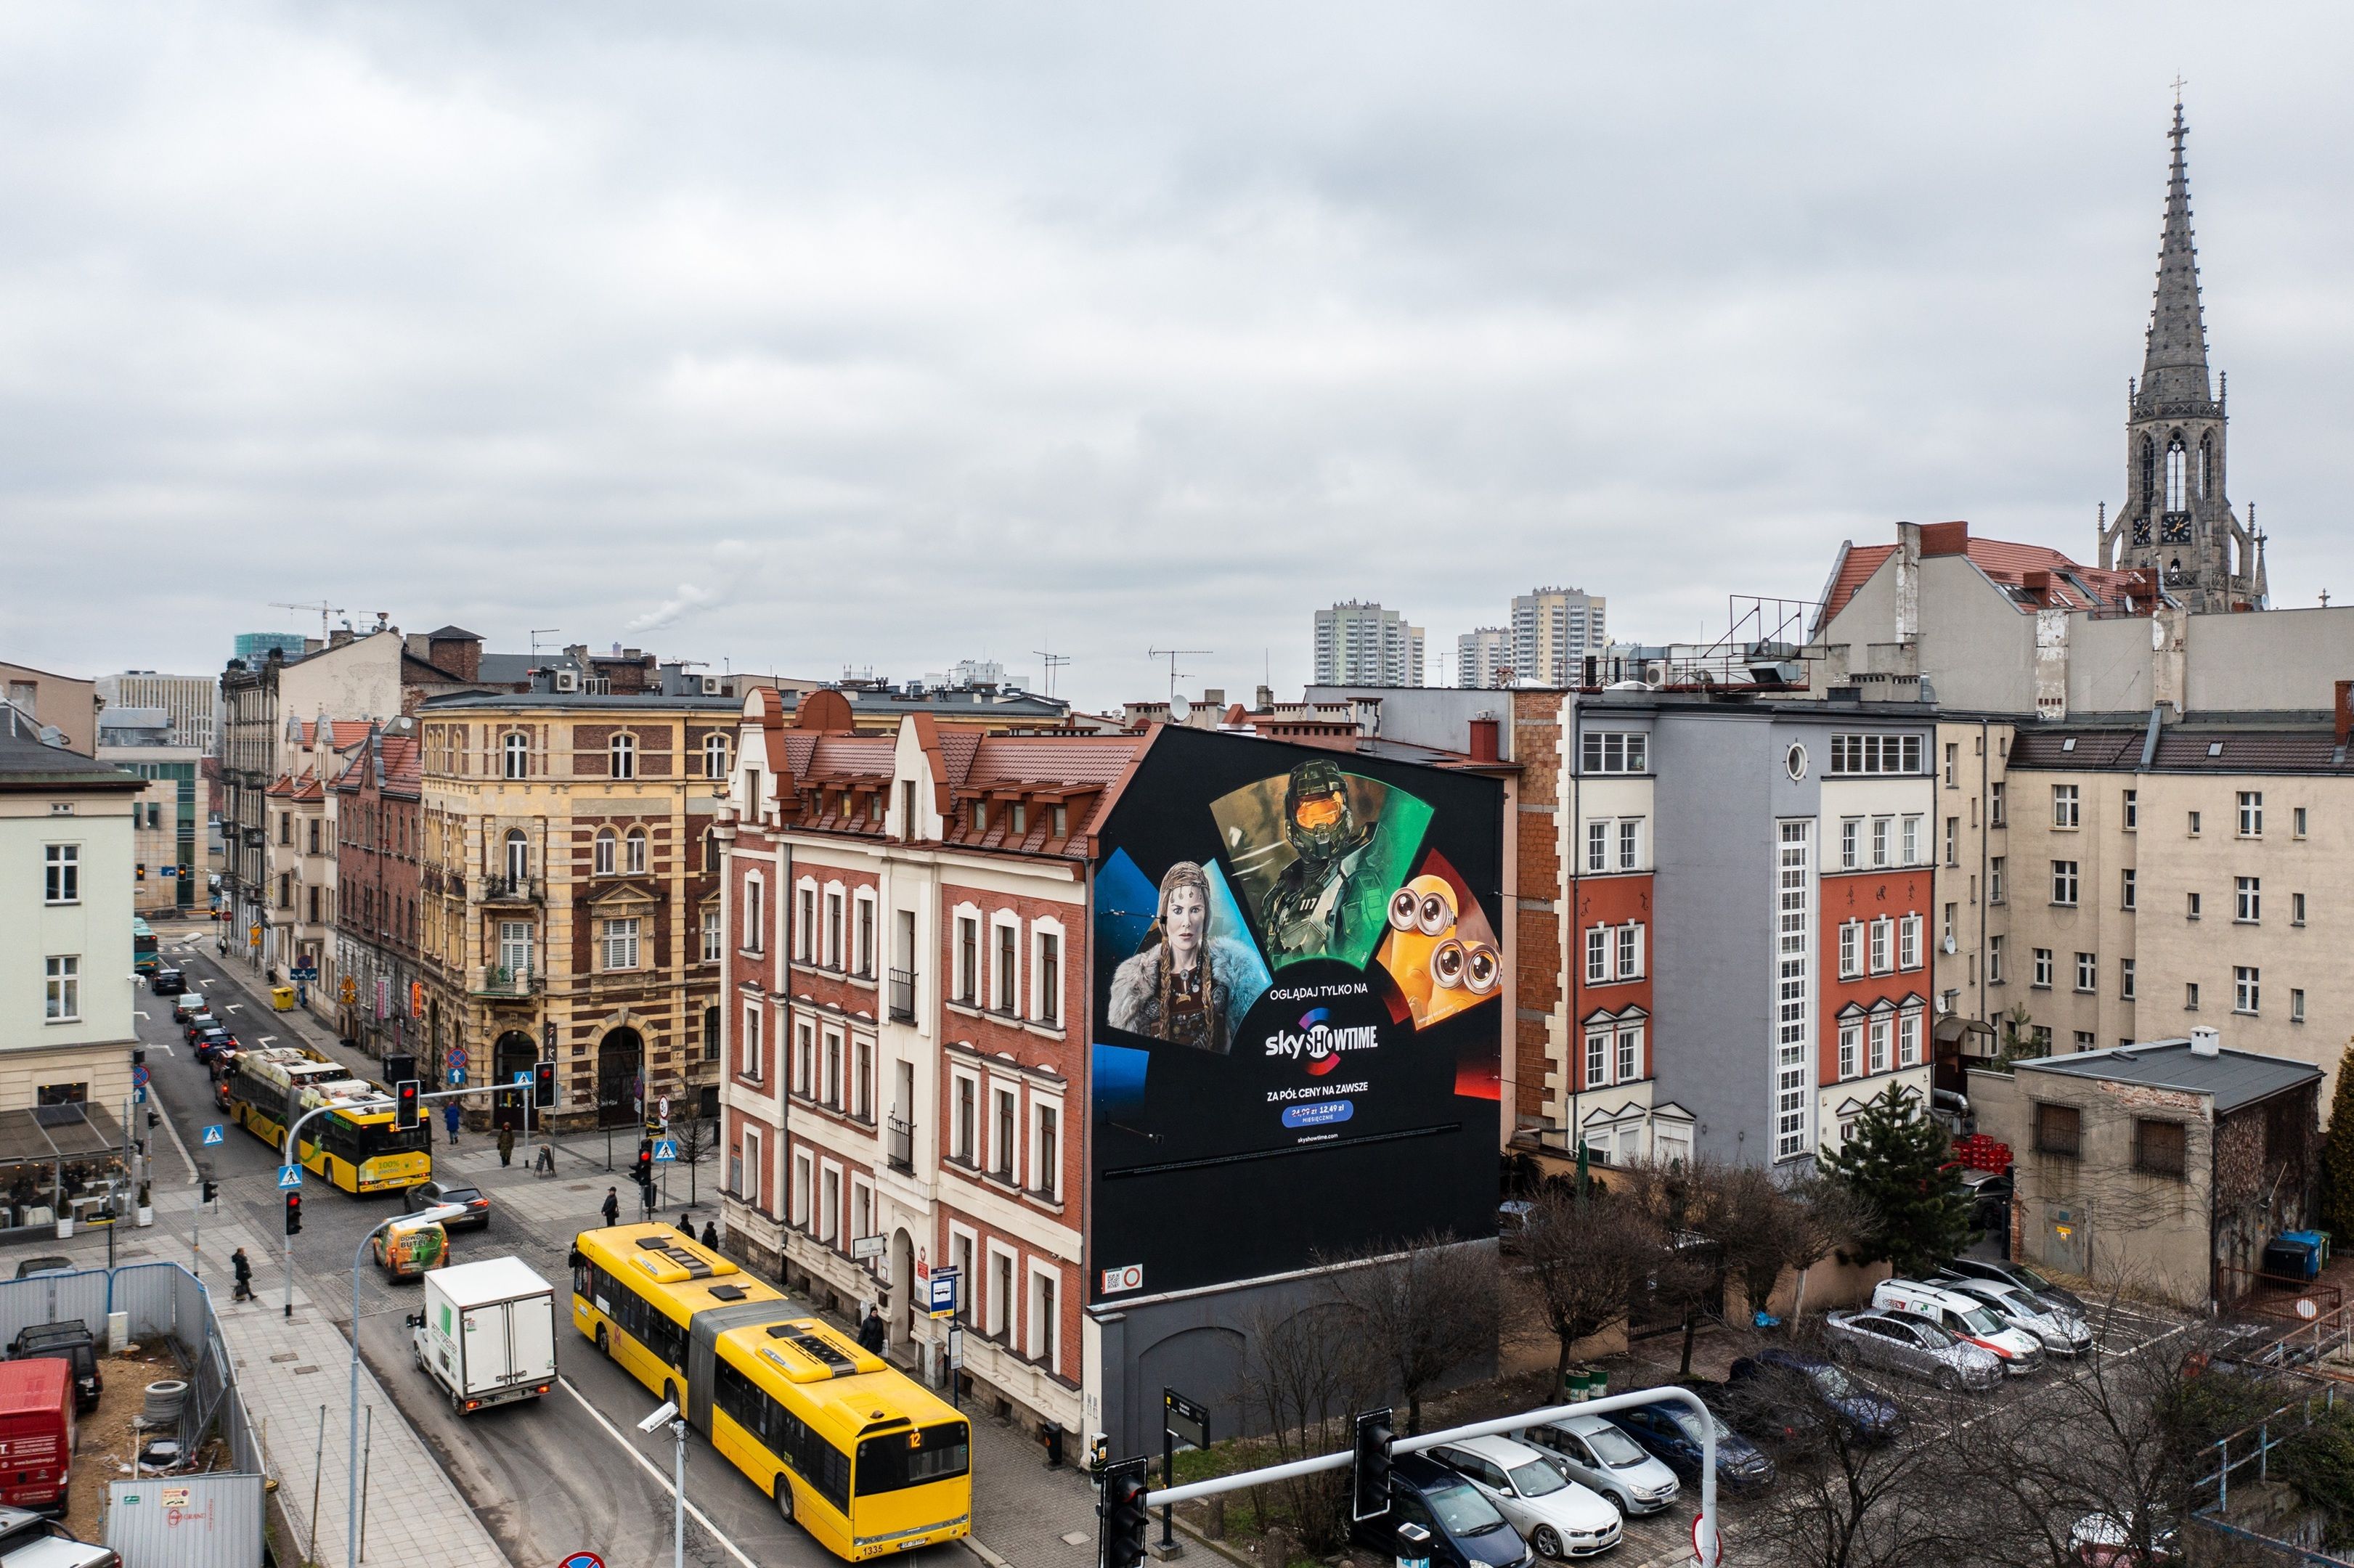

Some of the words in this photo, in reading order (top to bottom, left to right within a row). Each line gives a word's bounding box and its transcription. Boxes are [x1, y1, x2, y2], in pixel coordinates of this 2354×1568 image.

[1299, 898, 1318, 911] 117
[1270, 987, 1319, 1001] OGLĄDAJ
[1320, 984, 1352, 997] TYLKO
[1353, 983, 1368, 993] NA
[1267, 1092, 1279, 1102] ZA
[1279, 1087, 1298, 1101] PÓŁ
[1298, 1087, 1321, 1098] CENY
[1322, 1085, 1335, 1096] NA
[1335, 1082, 1369, 1095] ZAWSZE
[1319, 1104, 1337, 1114] 12,49
[1302, 1114, 1335, 1123] MIESIĘCZNIE
[1298, 1133, 1338, 1144] skyshowtime.com
[378, 1159, 400, 1169] 100%
[401, 1240, 426, 1249] BUTLI
[650, 1411, 672, 1430] Autoscope
[910, 1432, 921, 1448] 12
[863, 1545, 883, 1556] 1335
